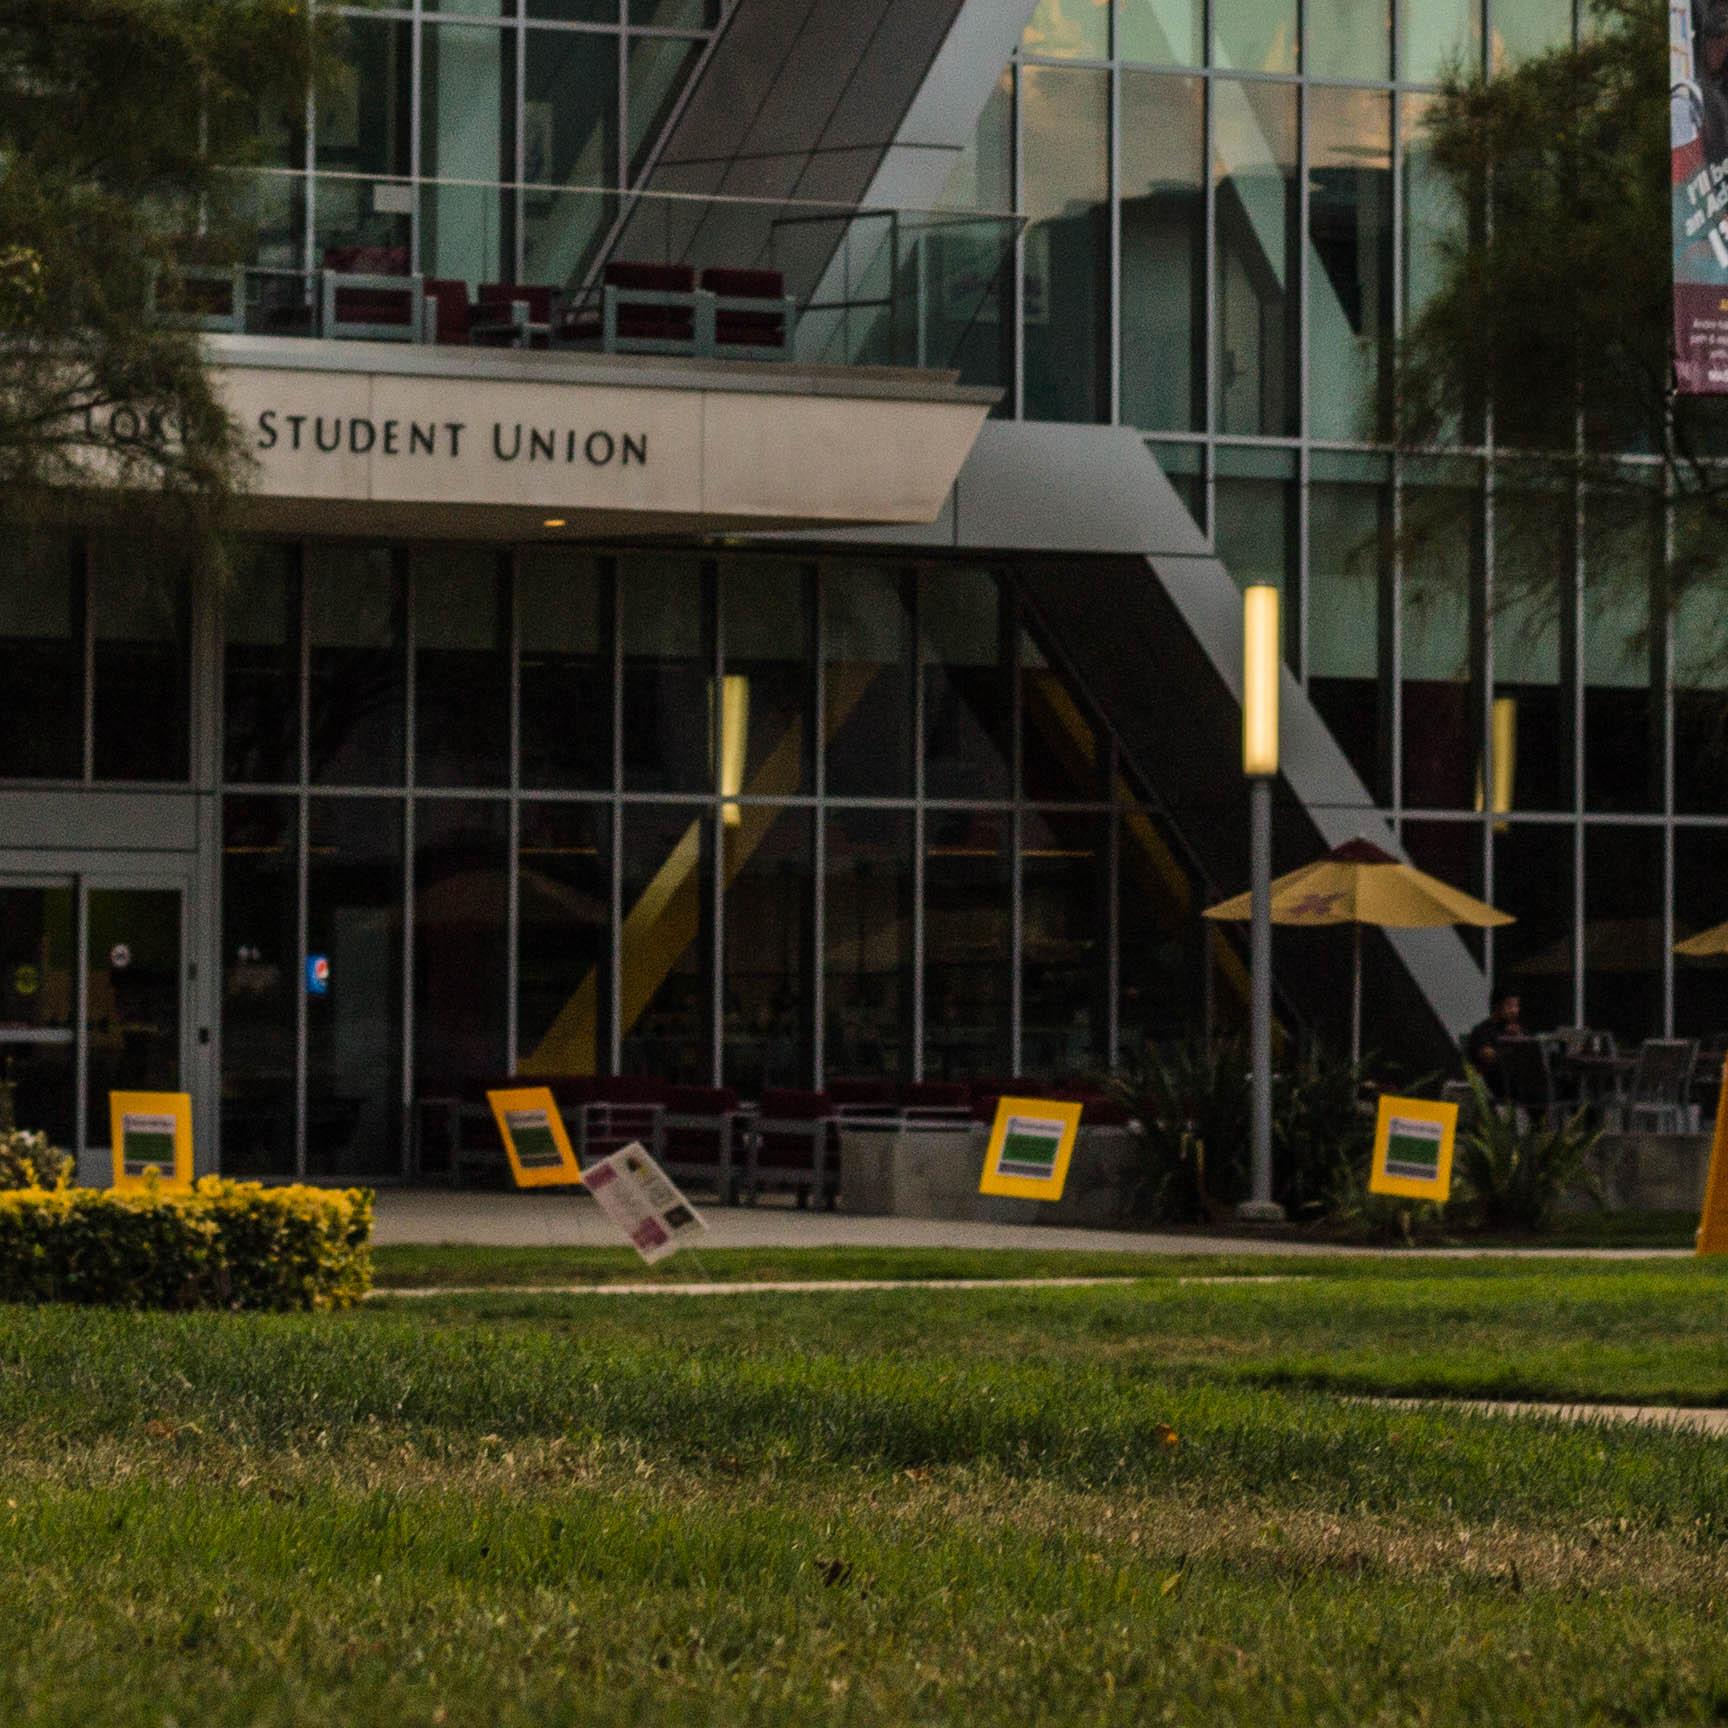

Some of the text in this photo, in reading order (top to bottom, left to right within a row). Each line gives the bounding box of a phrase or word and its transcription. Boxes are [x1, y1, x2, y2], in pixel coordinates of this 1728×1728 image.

[1687, 169, 1713, 205] I'll
[1684, 209, 1706, 237] an
[257, 410, 466, 458] STUDENT
[492, 422, 649, 467] UNION
